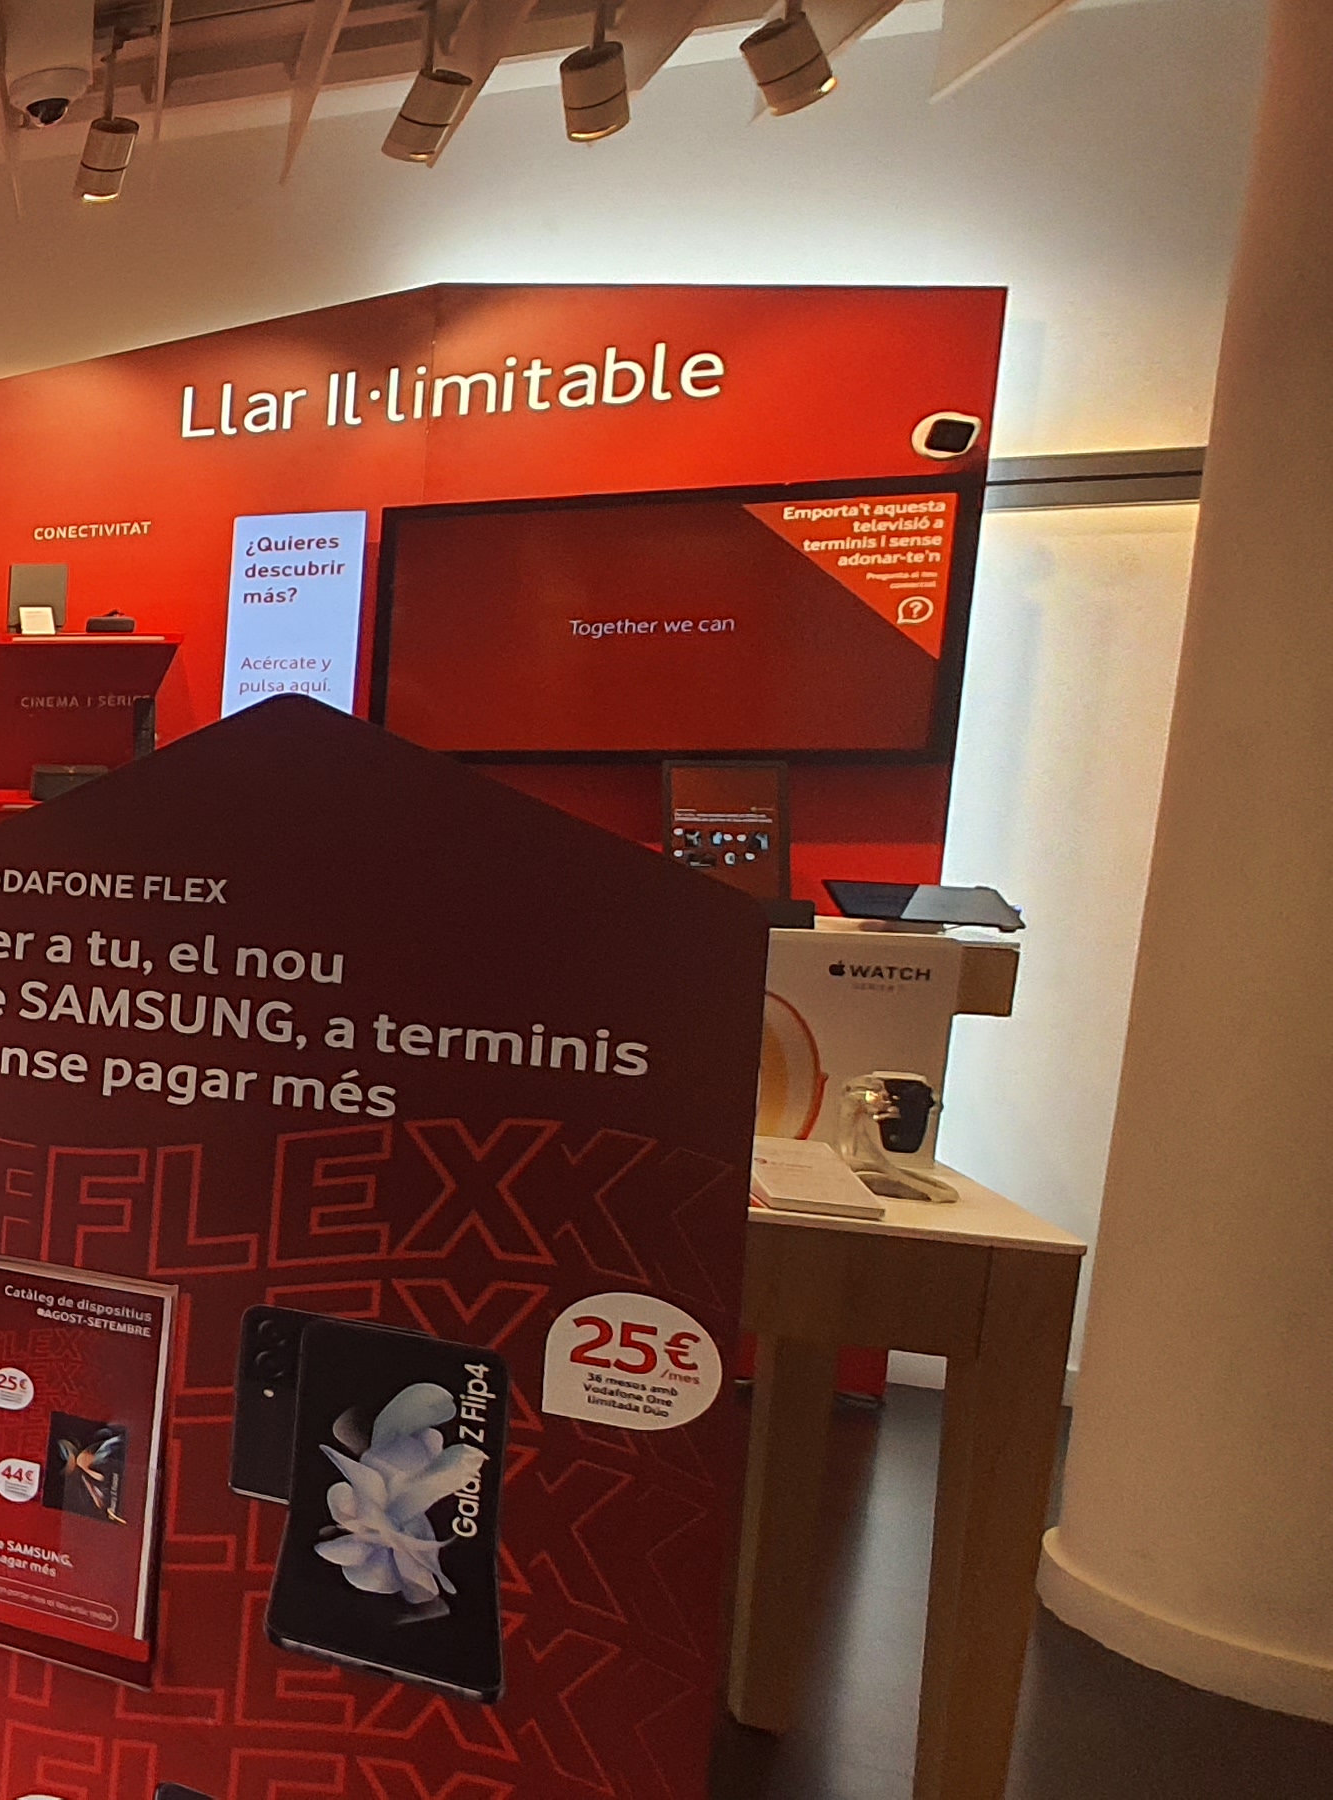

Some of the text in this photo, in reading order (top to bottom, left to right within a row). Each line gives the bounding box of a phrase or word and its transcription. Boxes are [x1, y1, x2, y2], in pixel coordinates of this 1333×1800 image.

[181, 382, 307, 438] Llar
[874, 500, 946, 517] aquesta
[34, 521, 151, 540] CONECTIVITAT
[853, 516, 944, 533] televisió a
[245, 536, 340, 556] ¿Quieres
[803, 535, 877, 551] terminis
[889, 535, 942, 547] sense
[837, 550, 941, 567] adonar-te'n
[244, 560, 345, 578] descubrir
[243, 587, 298, 604] más?
[569, 618, 735, 638] Together we can
[241, 656, 331, 672] Acércate y
[239, 678, 331, 695] pulsa aquí.
[20, 695, 80, 708] CINEMA
[98, 691, 150, 708] SÈRI
[143, 875, 227, 904] FLEX
[46, 933, 72, 963] a
[87, 930, 153, 976] tu,
[169, 934, 218, 975] el
[235, 945, 344, 984] nou
[850, 964, 931, 981] WATCH
[19, 980, 307, 1050] SAMSUNG,
[324, 1016, 355, 1049] a
[373, 1013, 649, 1076] terminis
[102, 1057, 258, 1106] pagar
[272, 1069, 396, 1117] més
[4, 1284, 152, 1322] Catàleg de dispositius
[569, 1315, 701, 1375] 25€
[460, 1363, 496, 1423] Flip4
[584, 1383, 673, 1408] Vodafone One
[649, 1384, 678, 1397] amb
[459, 1425, 484, 1444] Z
[1, 1464, 34, 1483] 44€
[6, 1540, 74, 1567] SAMSUNG,
[29, 1562, 57, 1578] més
